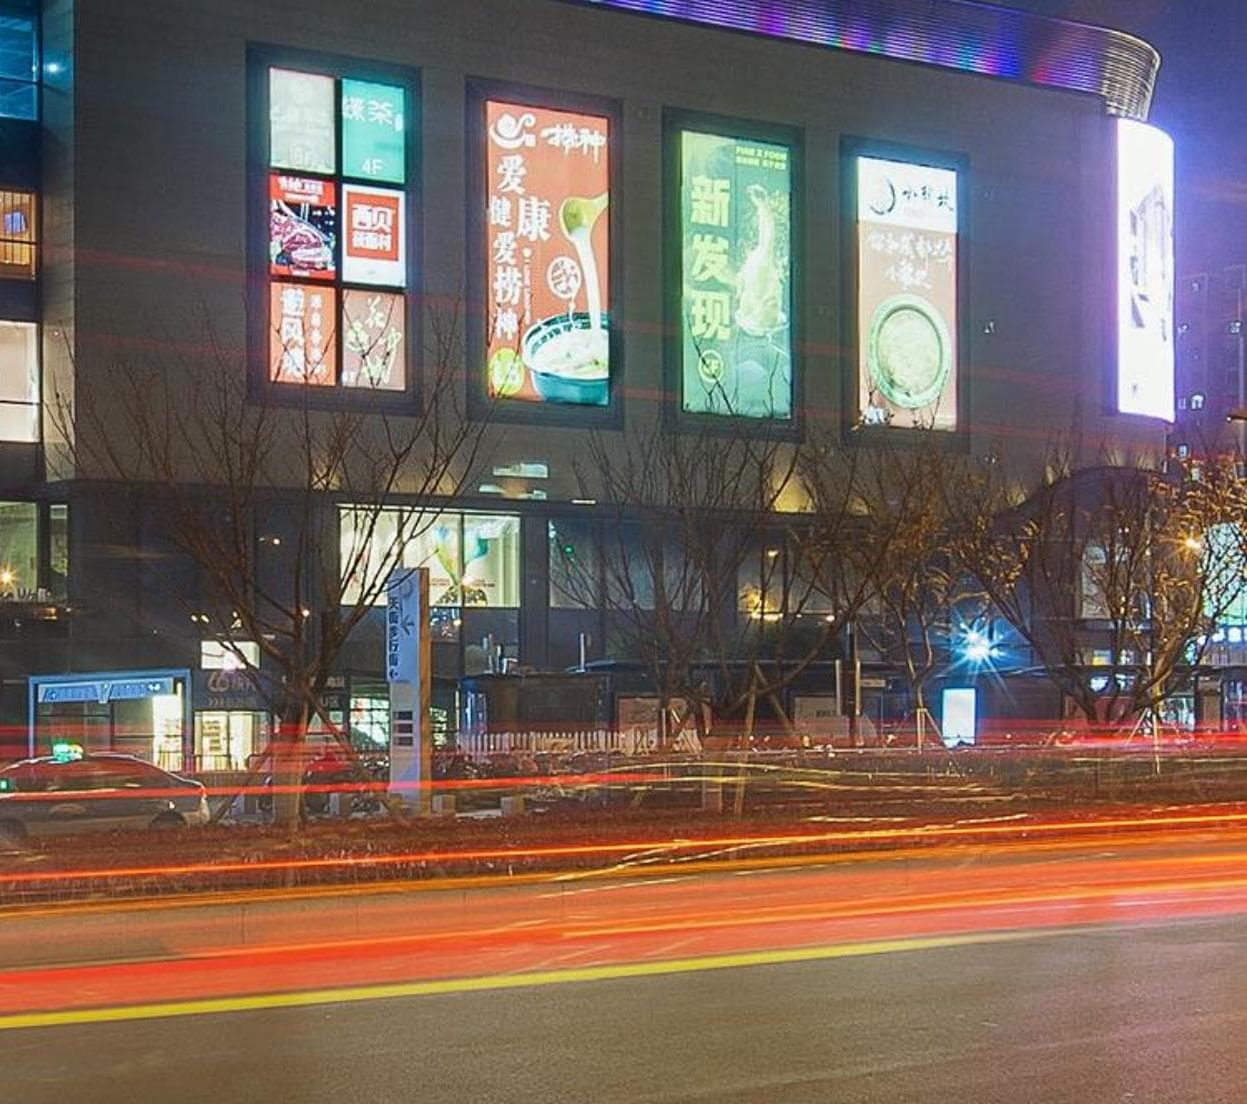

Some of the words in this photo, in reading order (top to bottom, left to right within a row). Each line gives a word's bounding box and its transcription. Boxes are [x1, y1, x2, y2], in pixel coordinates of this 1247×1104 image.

[362, 157, 383, 175] 4F
[690, 174, 731, 341] 新发现
